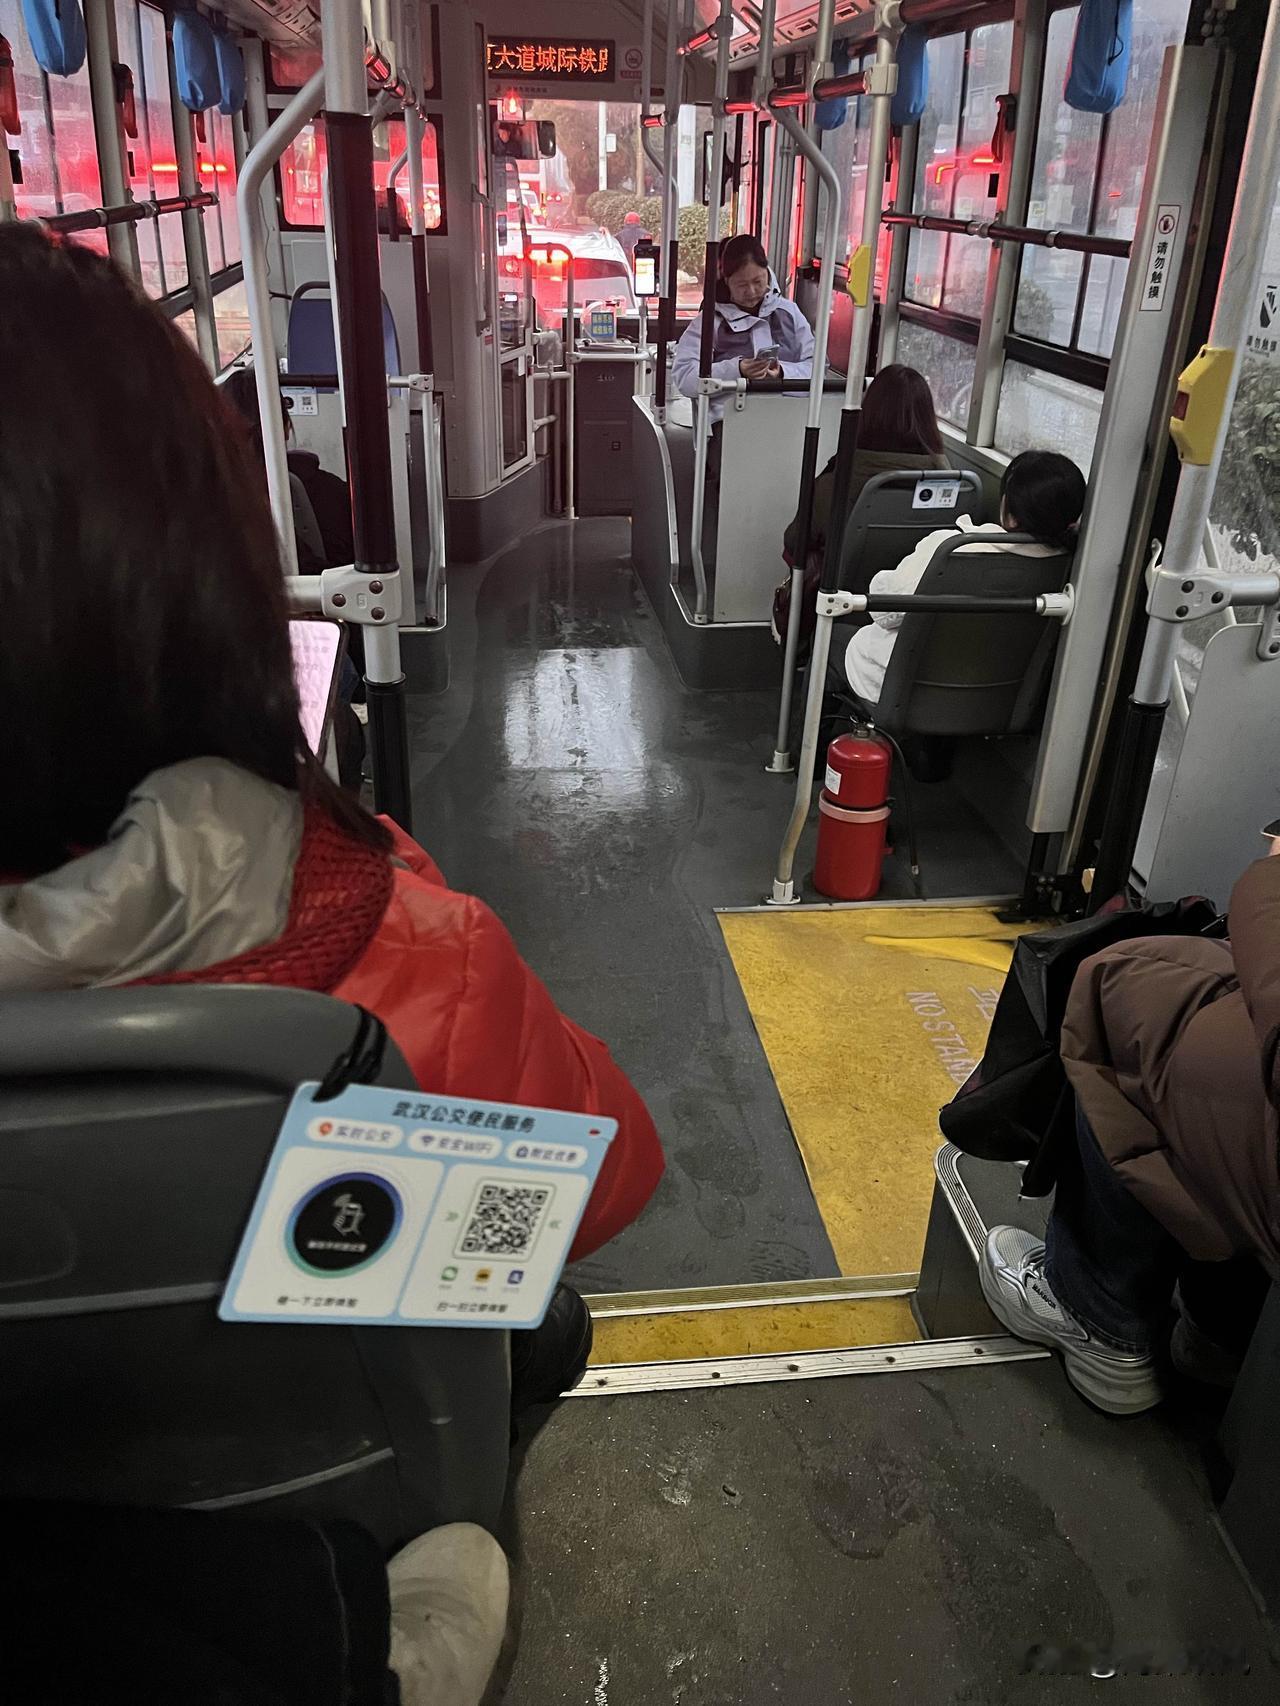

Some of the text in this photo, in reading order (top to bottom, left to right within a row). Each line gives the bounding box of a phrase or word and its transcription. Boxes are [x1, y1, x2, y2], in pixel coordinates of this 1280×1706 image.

[1147, 241, 1169, 299] 请勿触摸
[905, 991, 946, 1017] NO
[392, 1101, 536, 1133] 武汉公交便民服务
